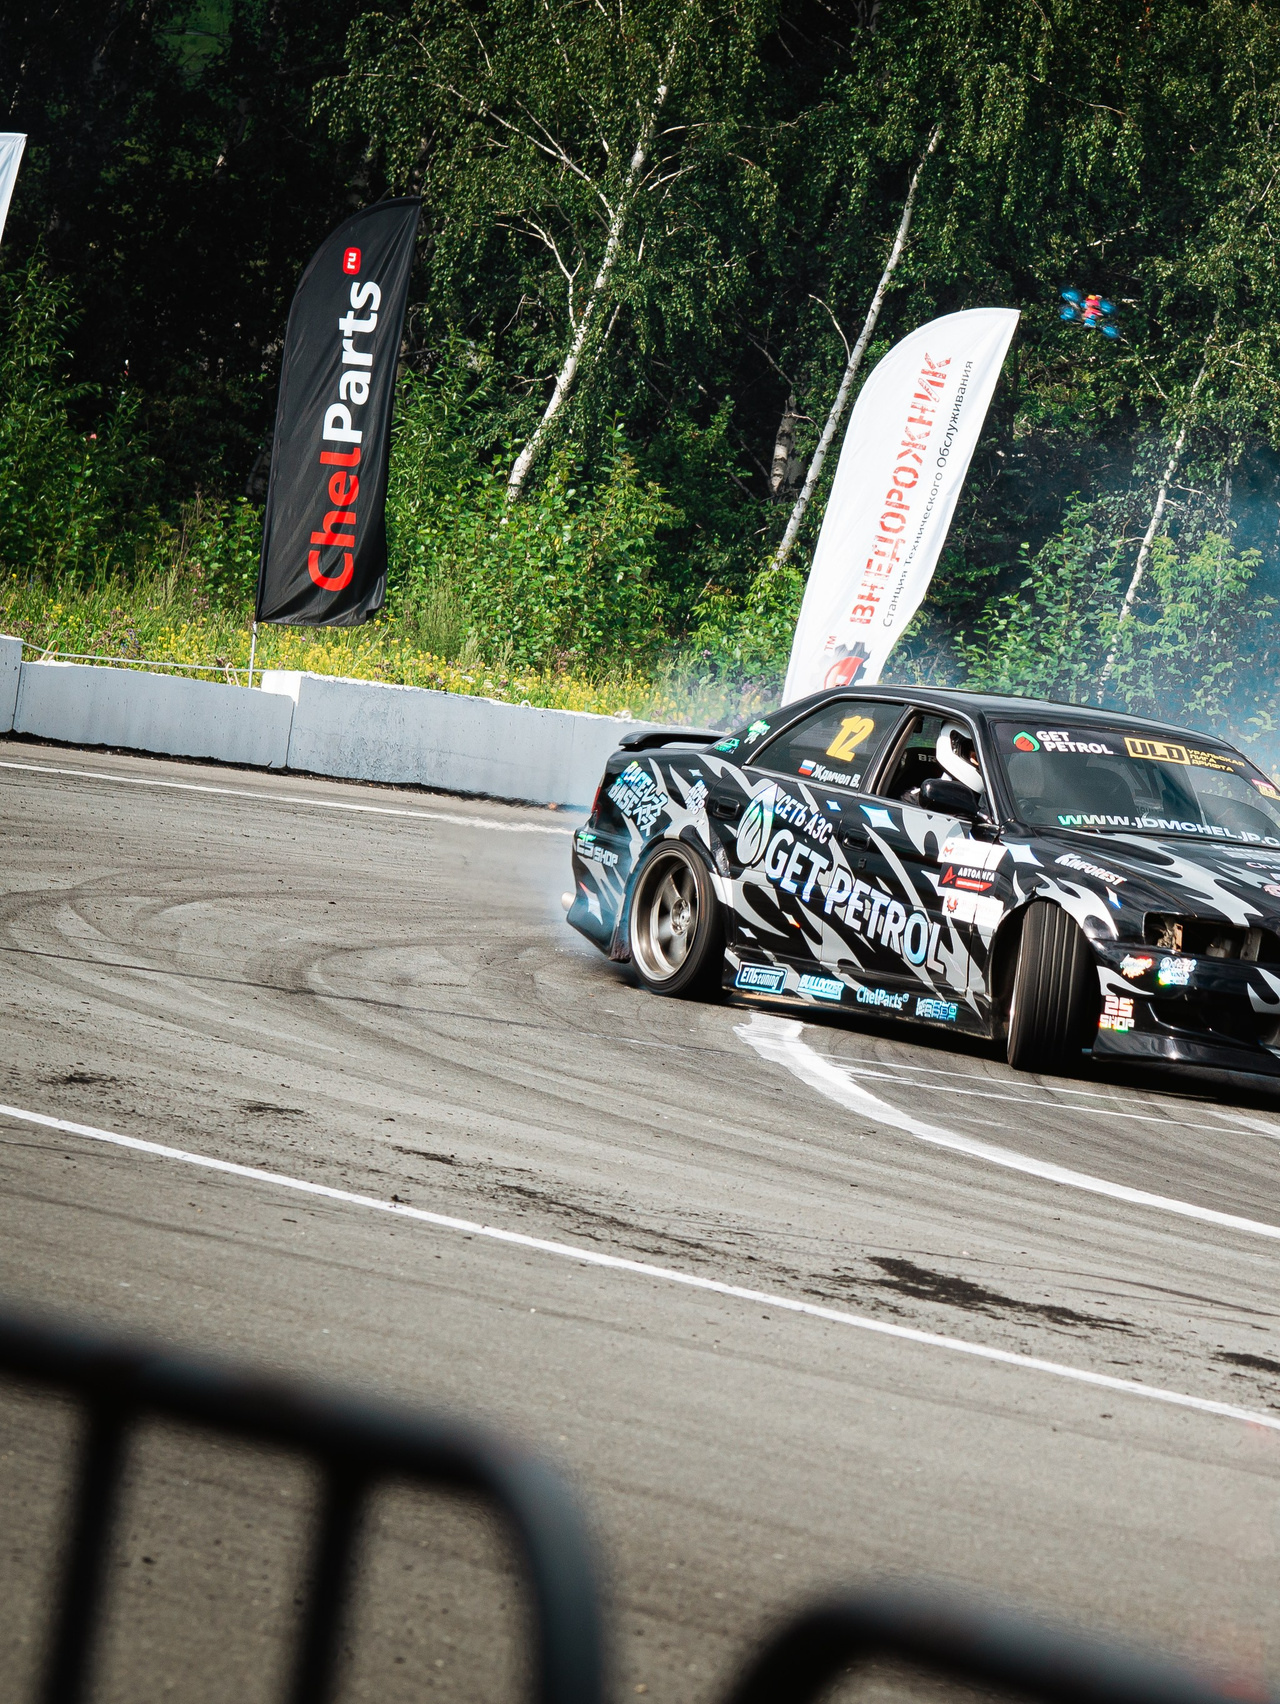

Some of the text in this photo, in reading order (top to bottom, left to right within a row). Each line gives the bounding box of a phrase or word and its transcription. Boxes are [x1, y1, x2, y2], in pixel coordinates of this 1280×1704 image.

[308, 251, 381, 591] ChelParts ru
[850, 352, 952, 626] ВНЕДОРОЖНИК
[883, 360, 974, 627] Станция Технического Обслуживания
[826, 715, 875, 762] 12
[1036, 730, 1070, 742] GET
[1043, 740, 1114, 755] PETROL
[1127, 739, 1187, 764] ULD
[1188, 748, 1246, 768] УРАЛЬСКАЯ
[1191, 758, 1234, 773] ДРИФТА
[774, 793, 833, 844] СЕТЬ АЗС
[765, 827, 947, 974] GET PETROL
[856, 986, 904, 1010] ChelParts
